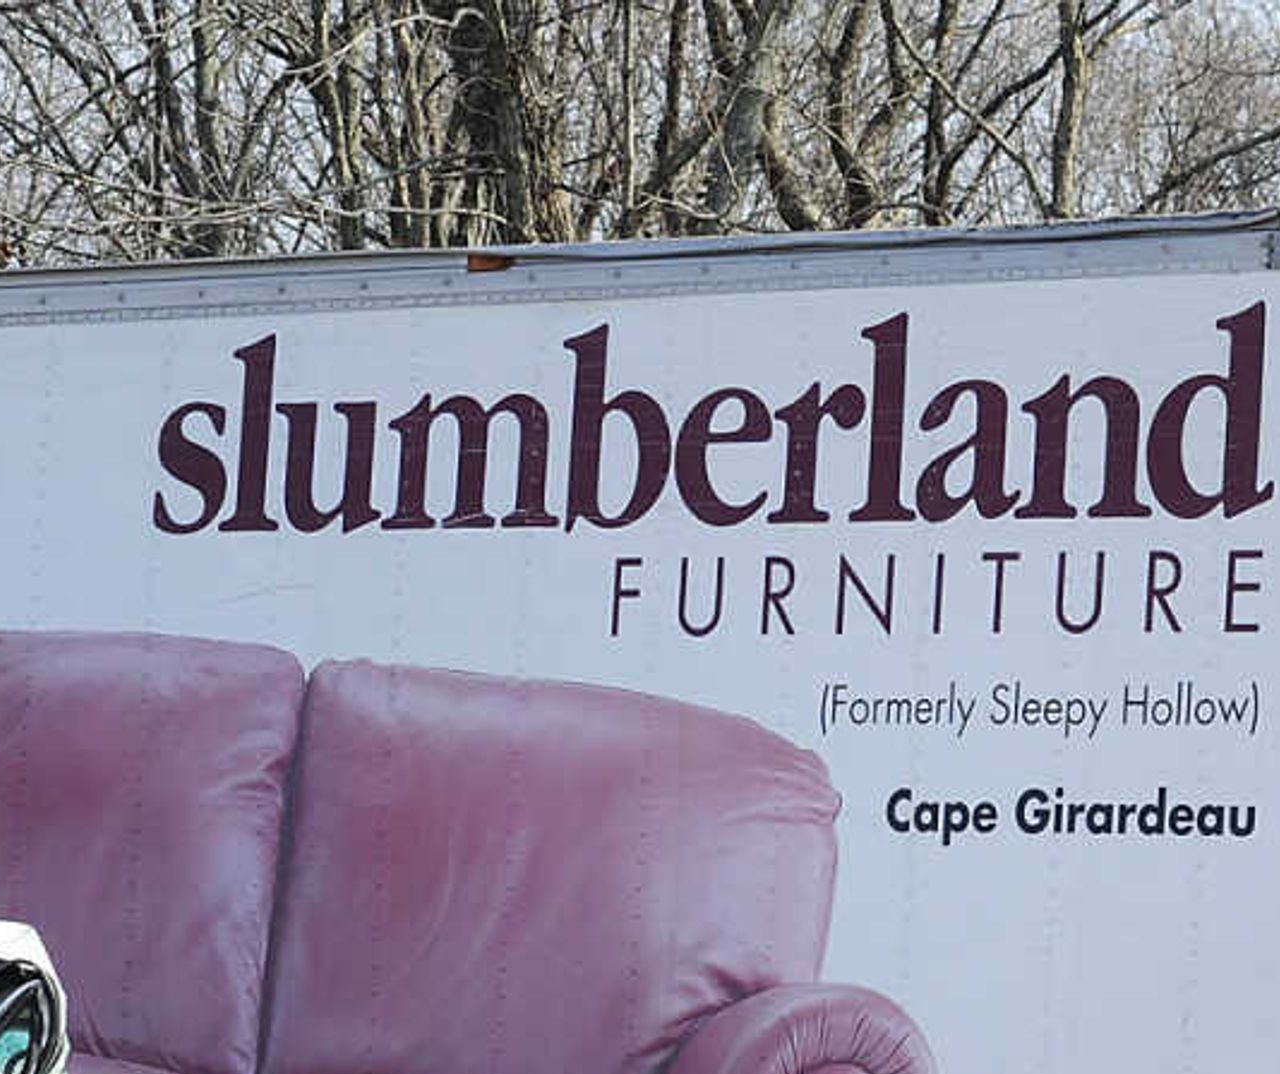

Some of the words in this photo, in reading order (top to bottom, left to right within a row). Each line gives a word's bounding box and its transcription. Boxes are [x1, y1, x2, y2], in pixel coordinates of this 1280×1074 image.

[153, 299, 1275, 535] slumberland
[611, 549, 1263, 638] FURNITURE
[820, 681, 975, 738] (Formerly
[990, 681, 1107, 738] Sleepy
[1121, 681, 1259, 734] Hollow)
[886, 787, 997, 846] Cape
[1015, 786, 1256, 836] Girardeau
